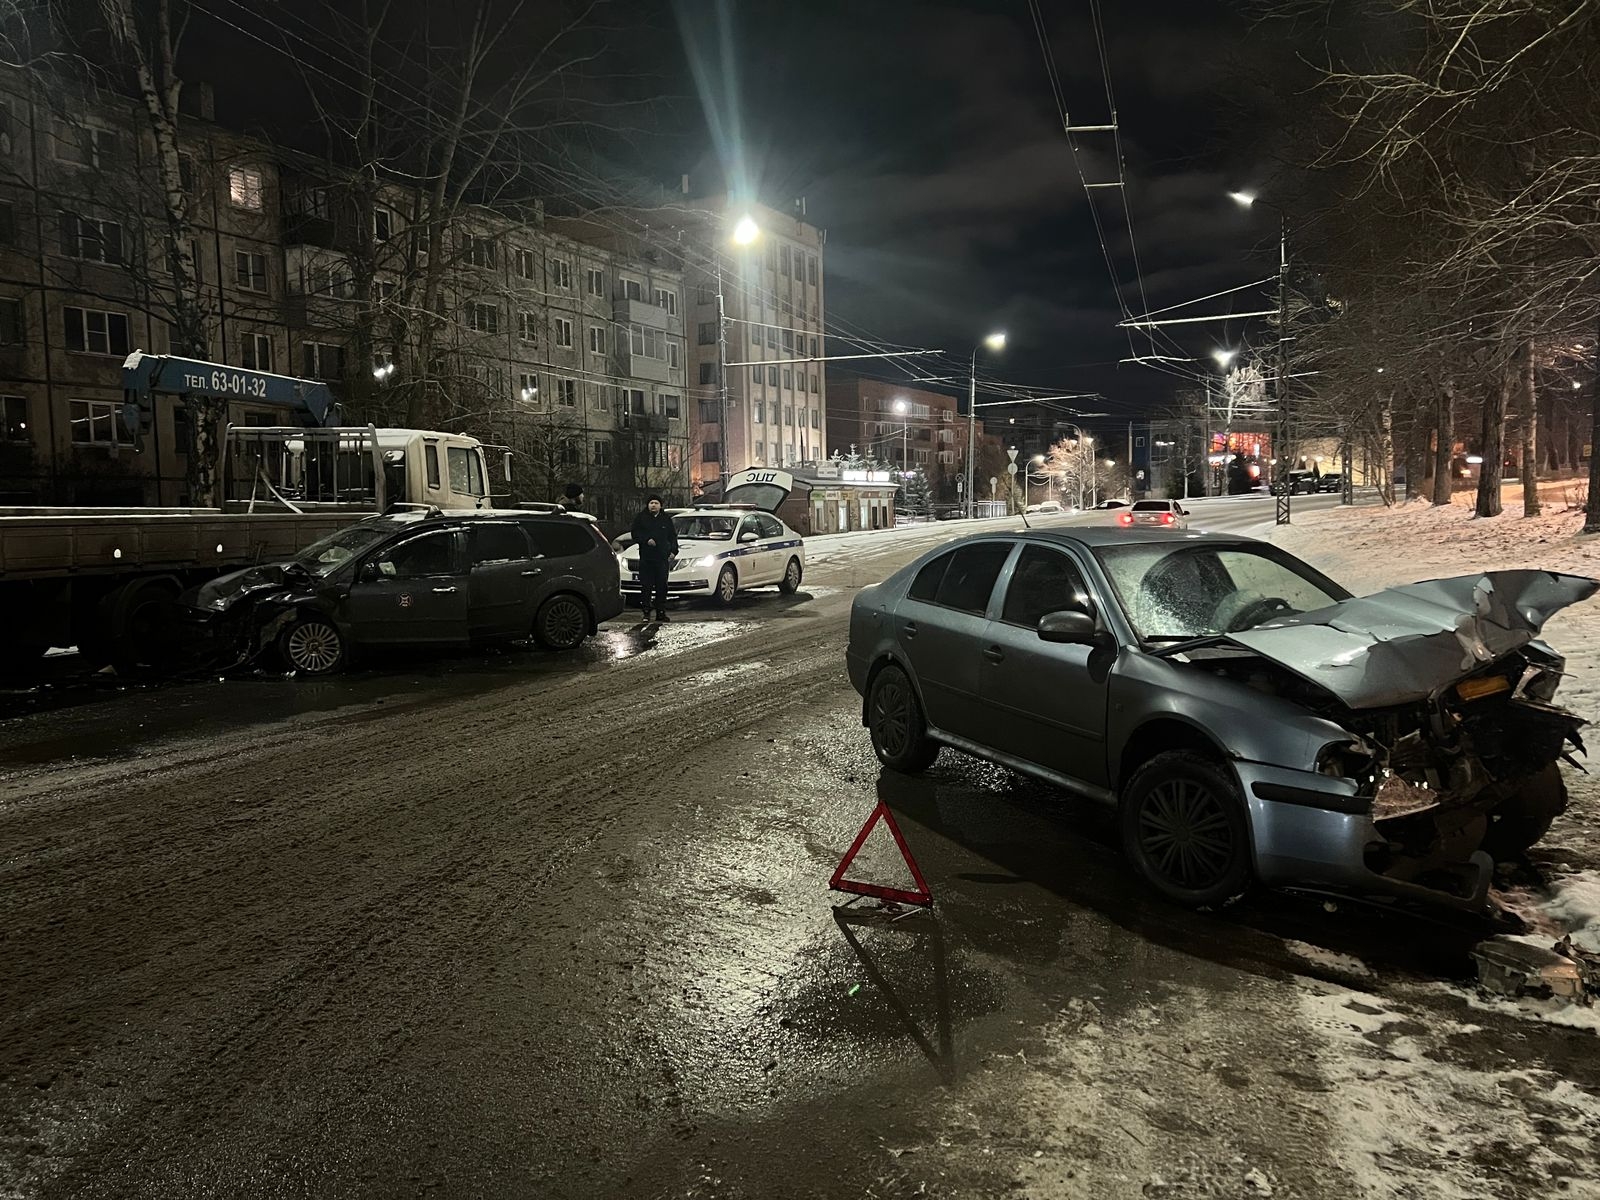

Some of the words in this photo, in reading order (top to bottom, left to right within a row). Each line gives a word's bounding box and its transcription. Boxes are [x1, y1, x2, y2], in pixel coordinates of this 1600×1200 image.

[184, 374, 209, 390] ТЕЛ.
[211, 371, 266, 398] 63-01-32
[746, 472, 777, 483] ДПС
